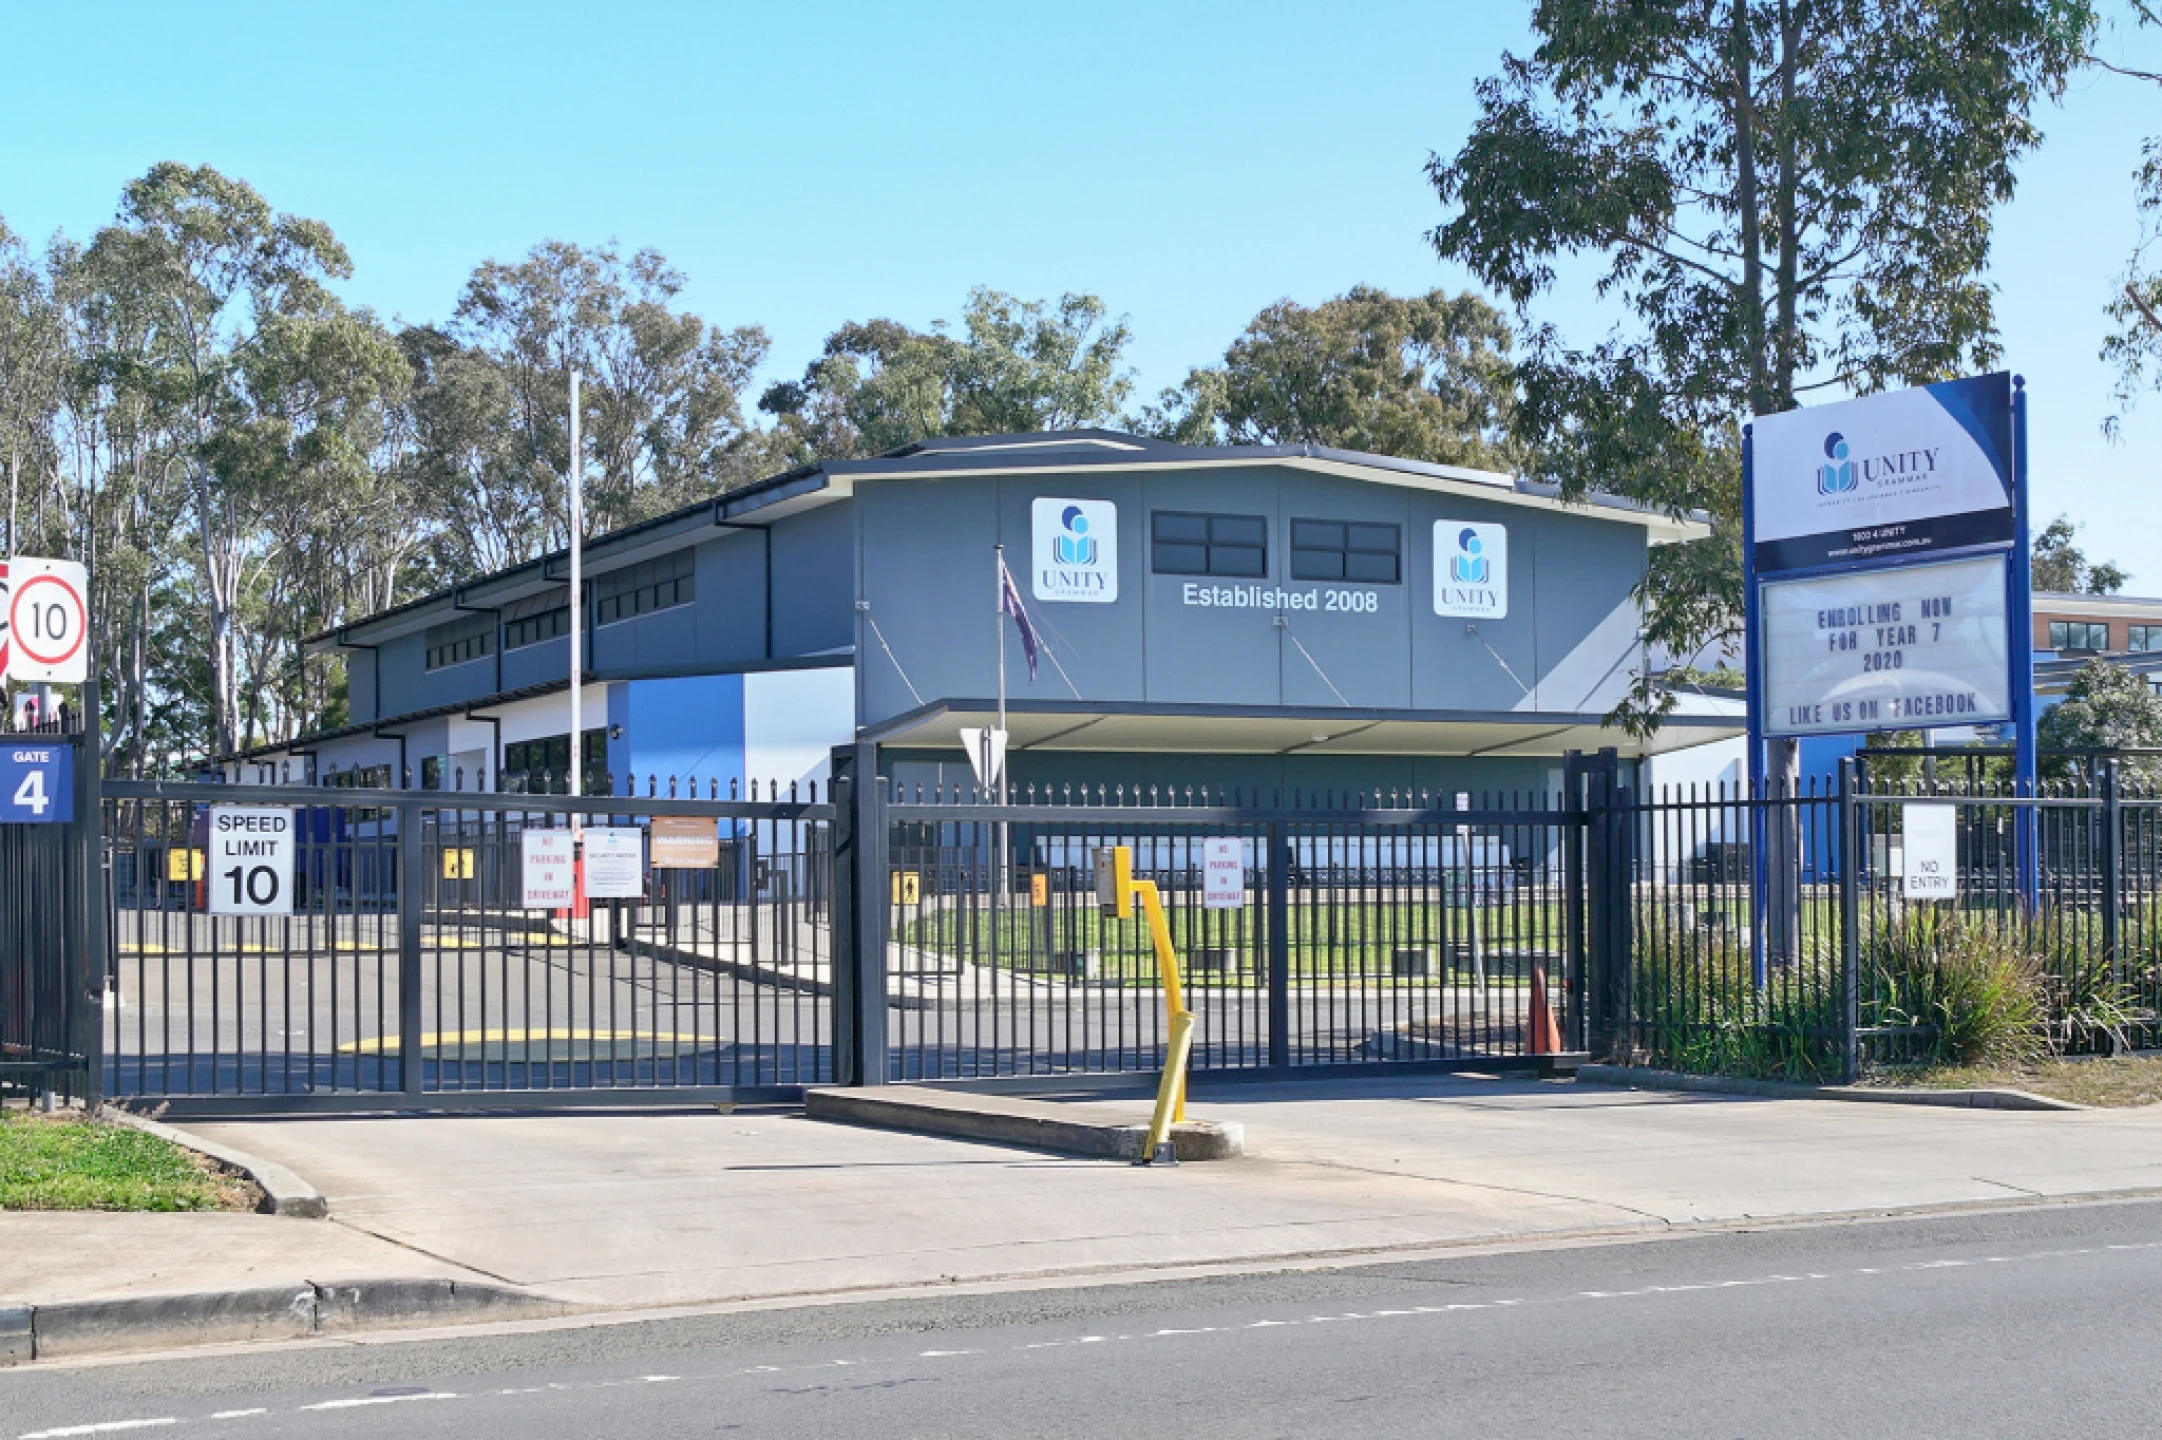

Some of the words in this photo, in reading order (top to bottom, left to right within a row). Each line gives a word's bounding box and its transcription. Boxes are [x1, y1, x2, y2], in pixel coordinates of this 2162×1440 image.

[1863, 447, 1940, 482] UNITY
[1042, 570, 1109, 590] UNITY
[1183, 582, 1318, 611] Established
[1325, 589, 1379, 613] 2008
[1442, 587, 1500, 607] UNITY
[31, 602, 67, 641] 10
[1817, 602, 1901, 630] ENROLLING
[1921, 597, 1952, 619] NOW
[1830, 631, 1857, 651] FOR
[1877, 625, 1917, 647] YEAR
[1932, 622, 1941, 643] 7
[1863, 650, 1903, 672] 2020
[1790, 704, 1822, 726] LIKE
[1832, 702, 1852, 721] US
[1859, 700, 1878, 719] ON
[1893, 692, 1977, 718] FACEBOOK
[12, 751, 50, 763] GATE
[12, 770, 50, 815] 4
[217, 814, 287, 832] SPEED
[225, 840, 278, 856] LIMIT
[542, 837, 554, 847] NO
[530, 854, 567, 865] PARKING
[1209, 861, 1238, 870] PARKING
[1920, 860, 1939, 873] NO
[224, 865, 280, 906] 10
[1910, 876, 1949, 889] ENTRY
[527, 888, 569, 900] DRIVEWAY
